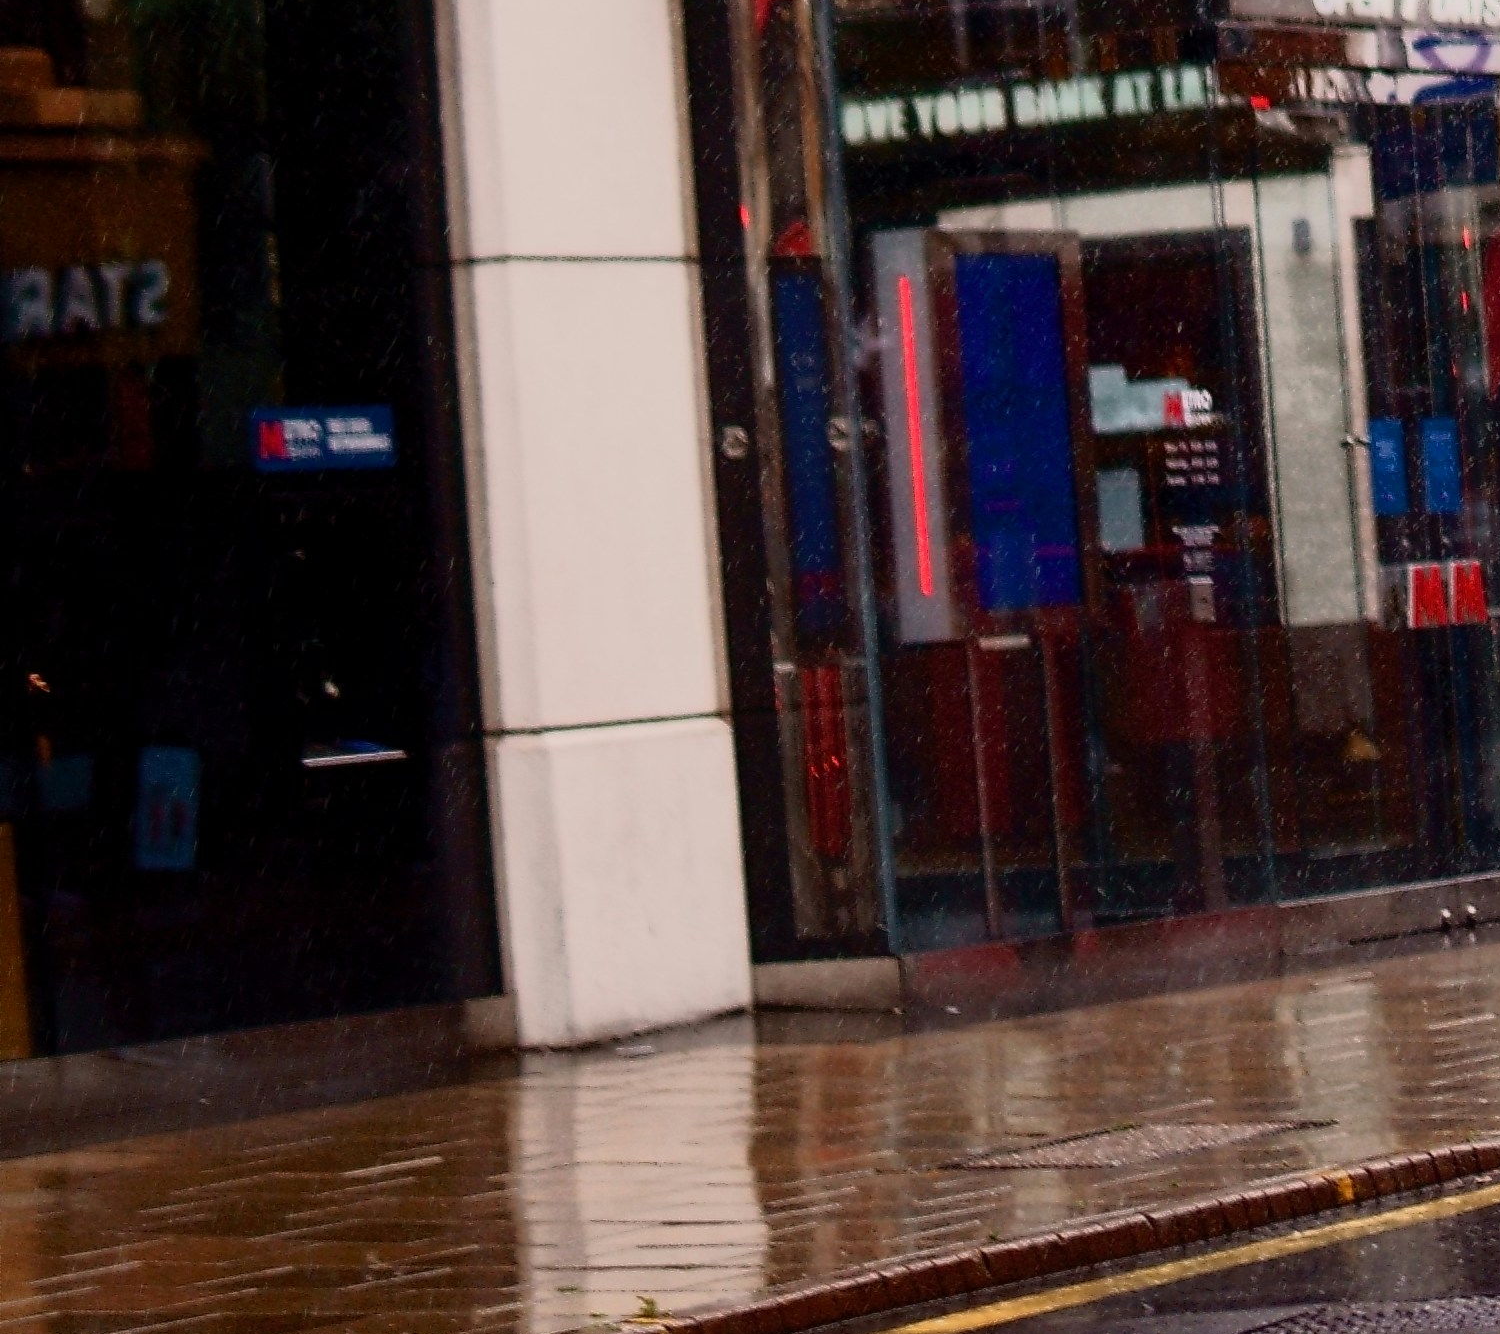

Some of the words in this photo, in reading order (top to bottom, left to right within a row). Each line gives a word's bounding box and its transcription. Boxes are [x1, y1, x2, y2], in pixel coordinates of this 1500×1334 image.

[842, 99, 906, 149] OVE
[912, 86, 1006, 141] YOUR
[1011, 74, 1106, 128] BANK
[1112, 70, 1153, 116] AT
